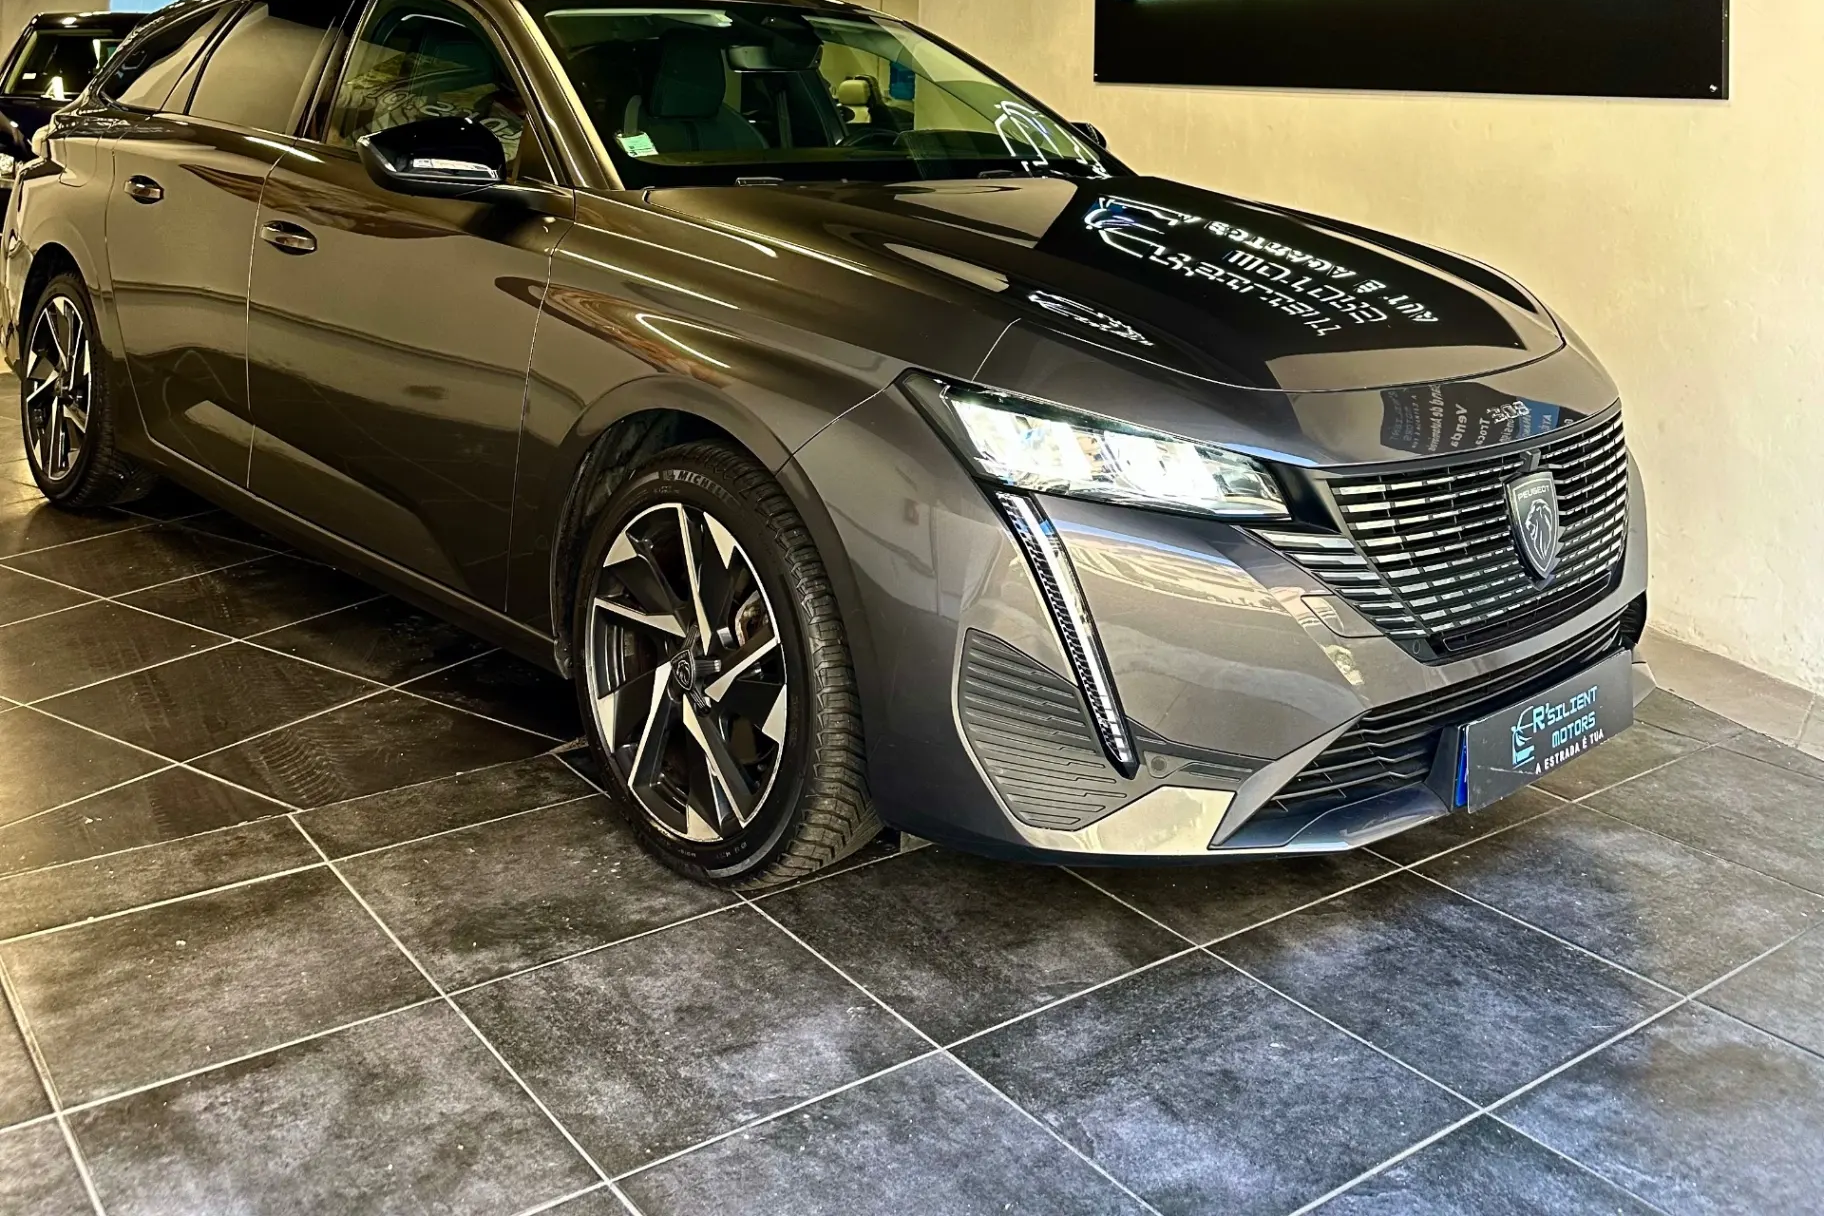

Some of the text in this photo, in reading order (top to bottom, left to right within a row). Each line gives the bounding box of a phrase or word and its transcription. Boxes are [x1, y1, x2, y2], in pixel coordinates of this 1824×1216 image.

[1517, 485, 1550, 501] PEUGEOT
[1533, 685, 1598, 733] R'SILIENT
[1552, 711, 1596, 748] MOTORS
[1535, 762, 1541, 774] A
[1544, 742, 1580, 770] ESTRADA
[1589, 728, 1604, 744] TUA
